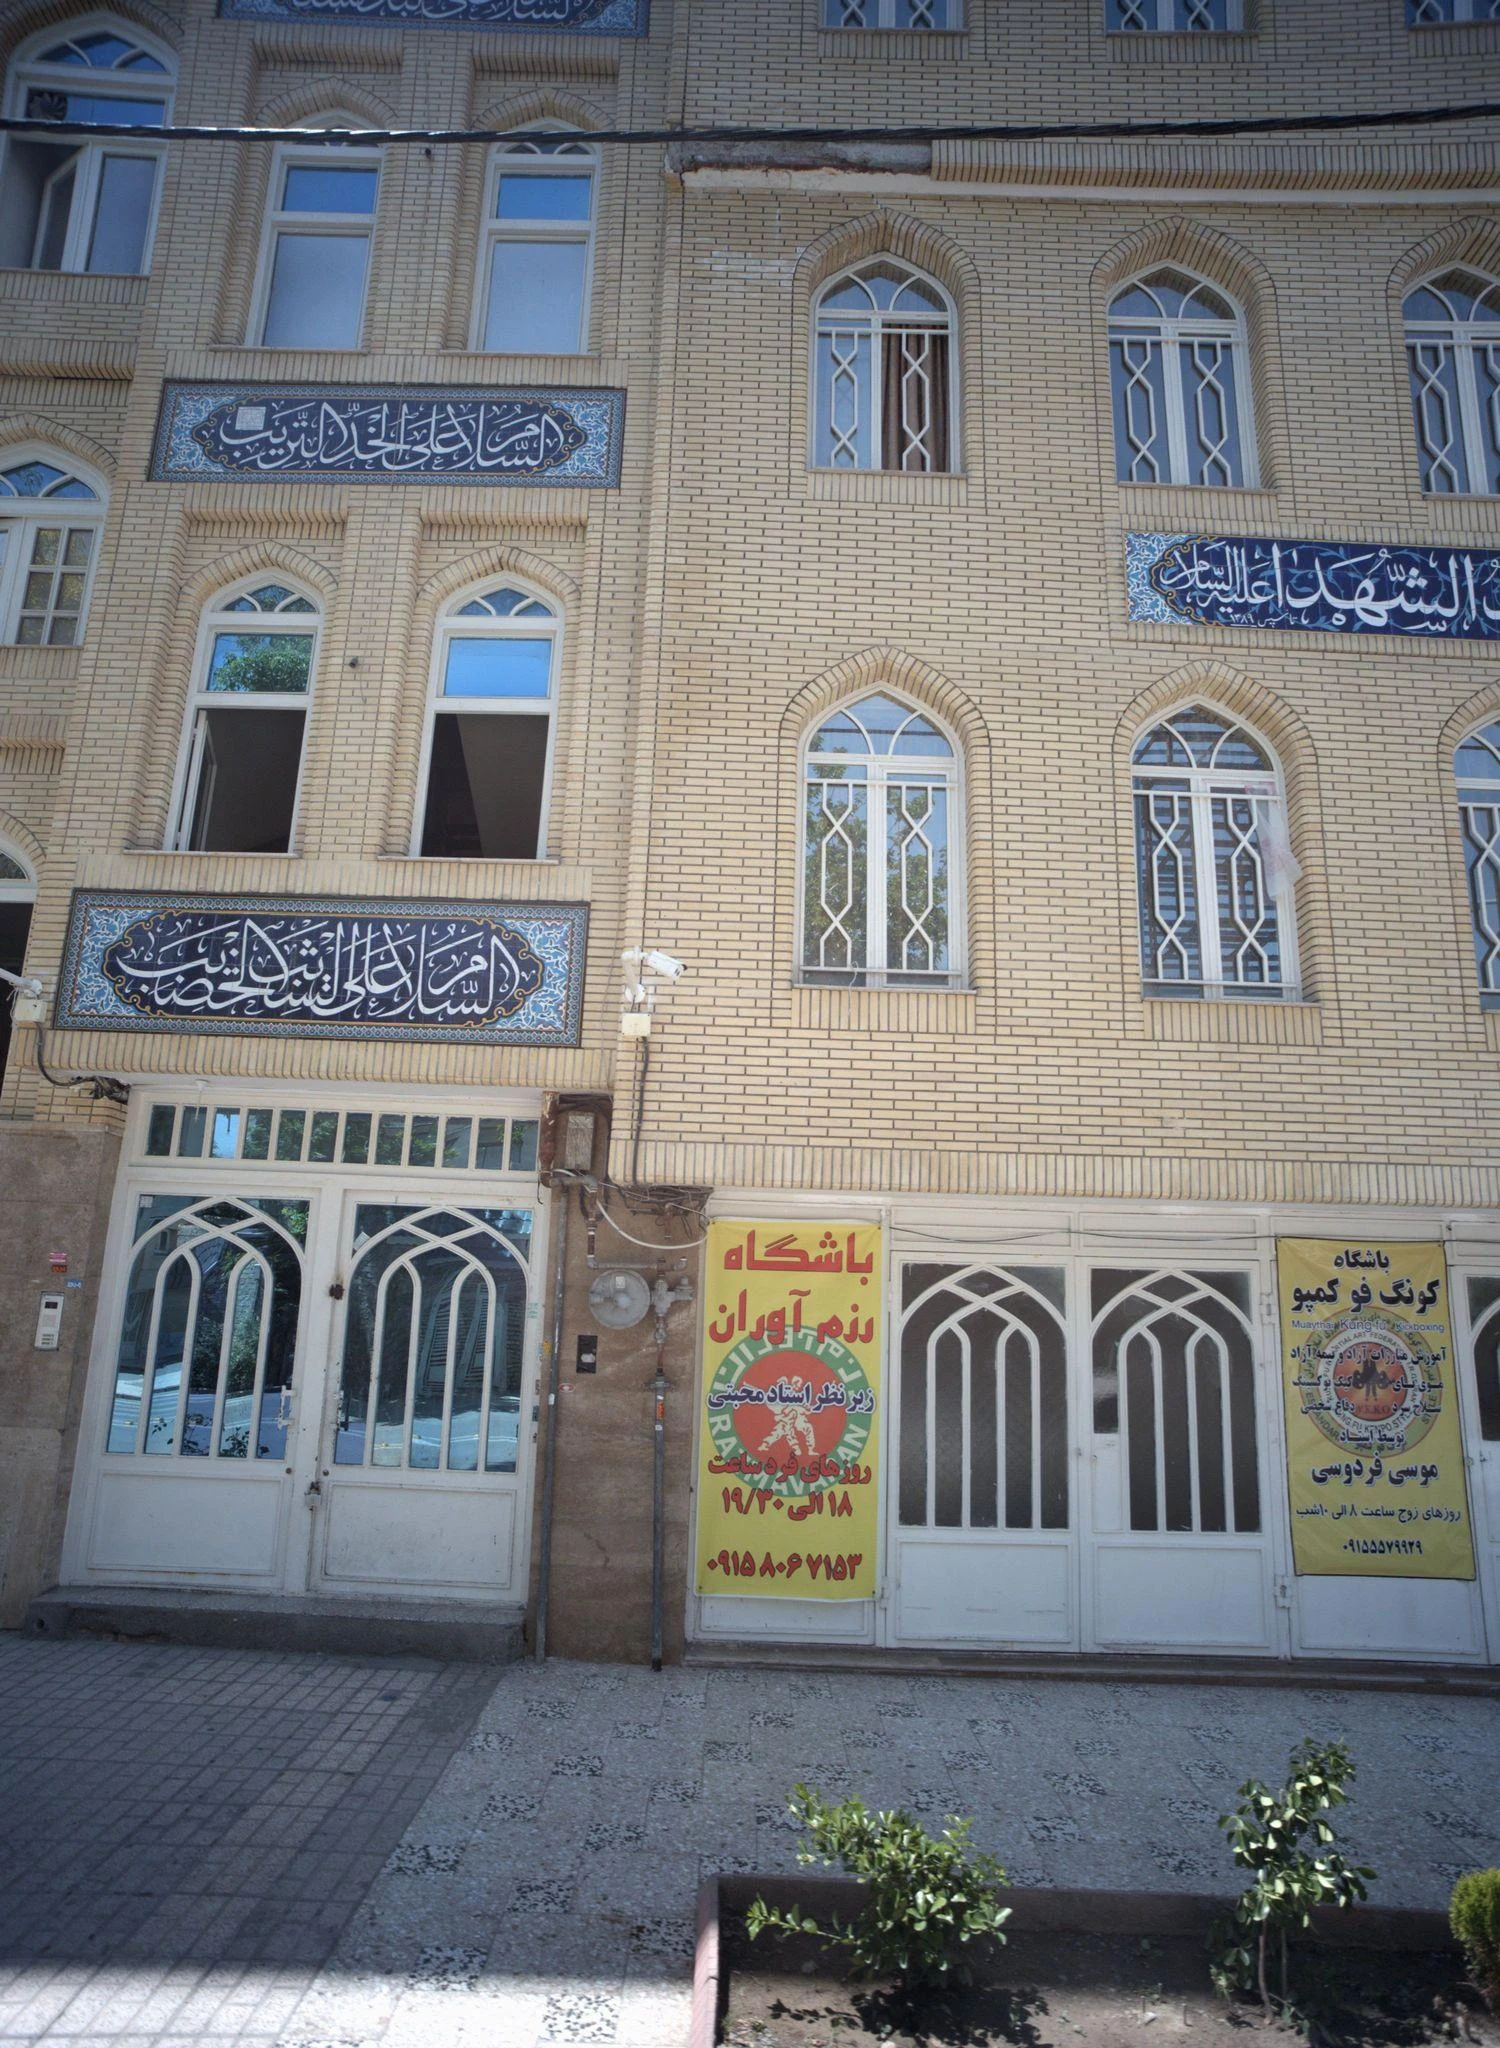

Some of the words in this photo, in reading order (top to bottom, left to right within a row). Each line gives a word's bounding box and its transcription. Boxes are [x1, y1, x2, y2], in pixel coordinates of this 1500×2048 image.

[723, 1229, 874, 1286] باشگاه
[1333, 1249, 1390, 1274] باشگاه
[1290, 1278, 1340, 1313] کمپو
[1350, 1276, 1373, 1313] فو
[1379, 1278, 1441, 1315] کونگ
[708, 1288, 812, 1345] آوران
[816, 1301, 874, 1344] رزم
[1340, 1319, 1373, 1334] Kung
[1290, 1345, 1312, 1364] آزاد
[1346, 1346, 1367, 1365] آزاد
[1411, 1347, 1447, 1366] آموزش
[766, 1382, 811, 1406] استاد
[811, 1382, 847, 1413] نظر
[846, 1386, 876, 1413] زیر
[1339, 1428, 1375, 1443] استاد
[1377, 1429, 1406, 1448] توسط
[707, 1453, 763, 1475] ساعت
[763, 1451, 799, 1483] فرد
[1311, 1451, 1384, 1485] فردوسی
[1388, 1463, 1439, 1486] موسی
[787, 1490, 825, 1522] الی
[828, 1490, 854, 1517] ۱۸
[1331, 1504, 1348, 1520] الی
[1349, 1505, 1358, 1517] ۸
[1361, 1505, 1395, 1516] ساعت
[1397, 1505, 1419, 1523] زوج
[1422, 1505, 1461, 1522] روزهای
